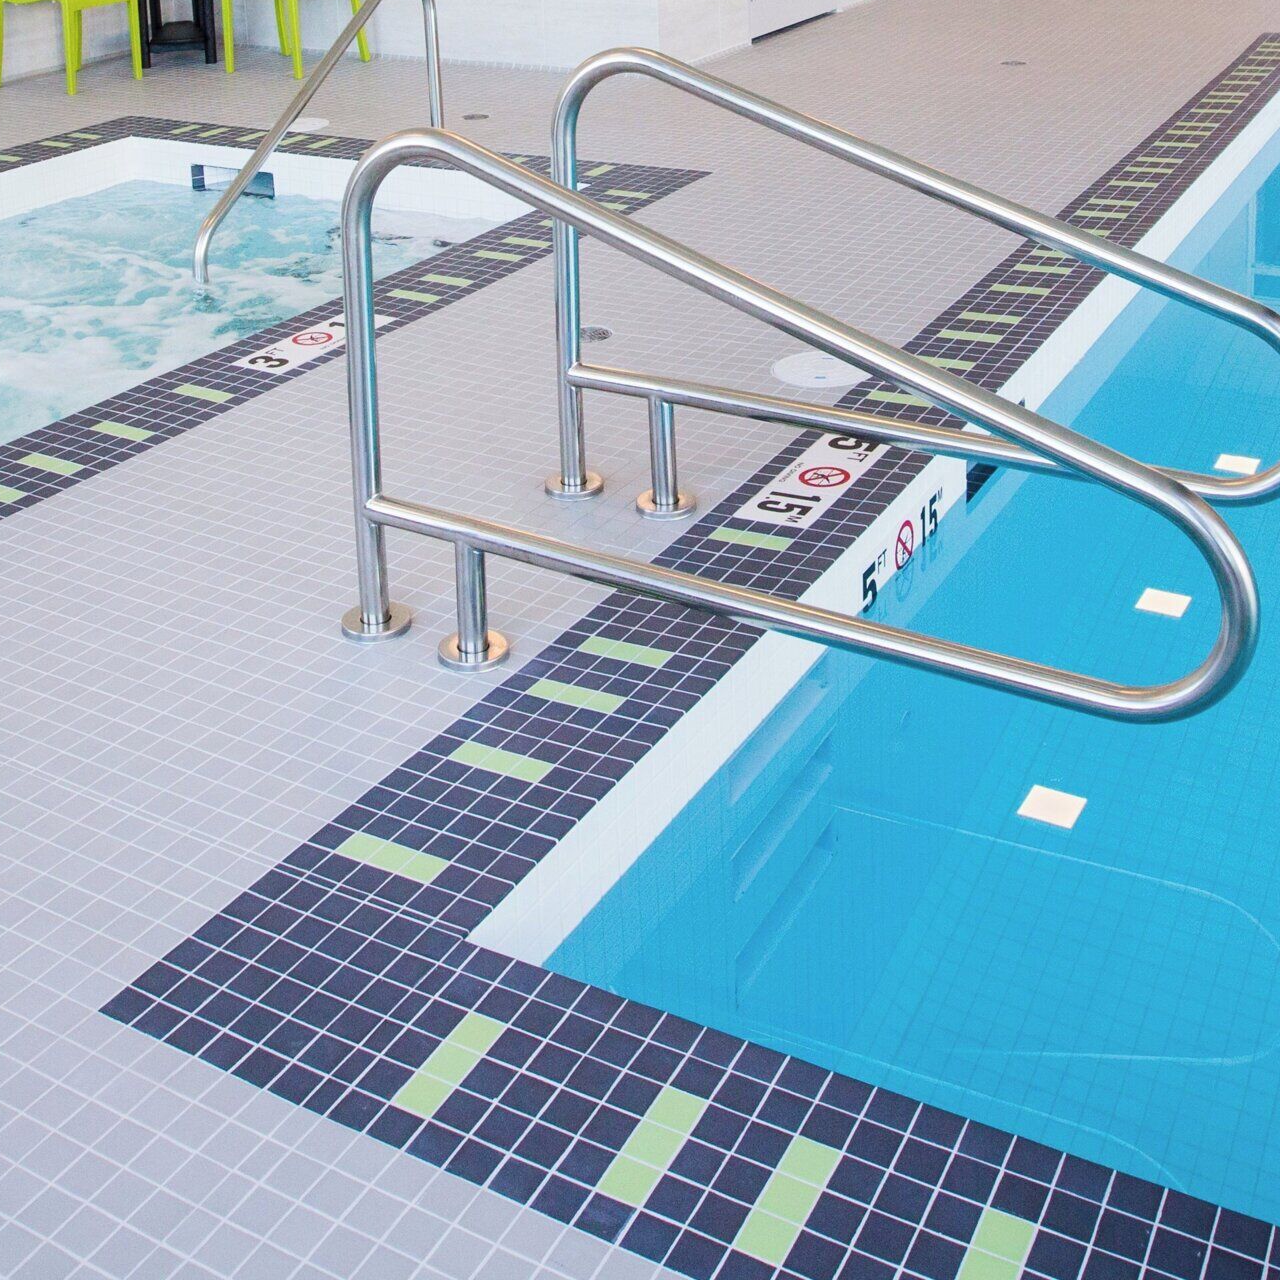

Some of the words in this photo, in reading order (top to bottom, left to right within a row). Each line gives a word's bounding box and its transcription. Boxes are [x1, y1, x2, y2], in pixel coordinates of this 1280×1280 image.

[248, 355, 289, 368] 3
[828, 436, 880, 452] 5
[847, 451, 869, 463] FT
[863, 561, 877, 613] 5
[877, 548, 887, 575] FT
